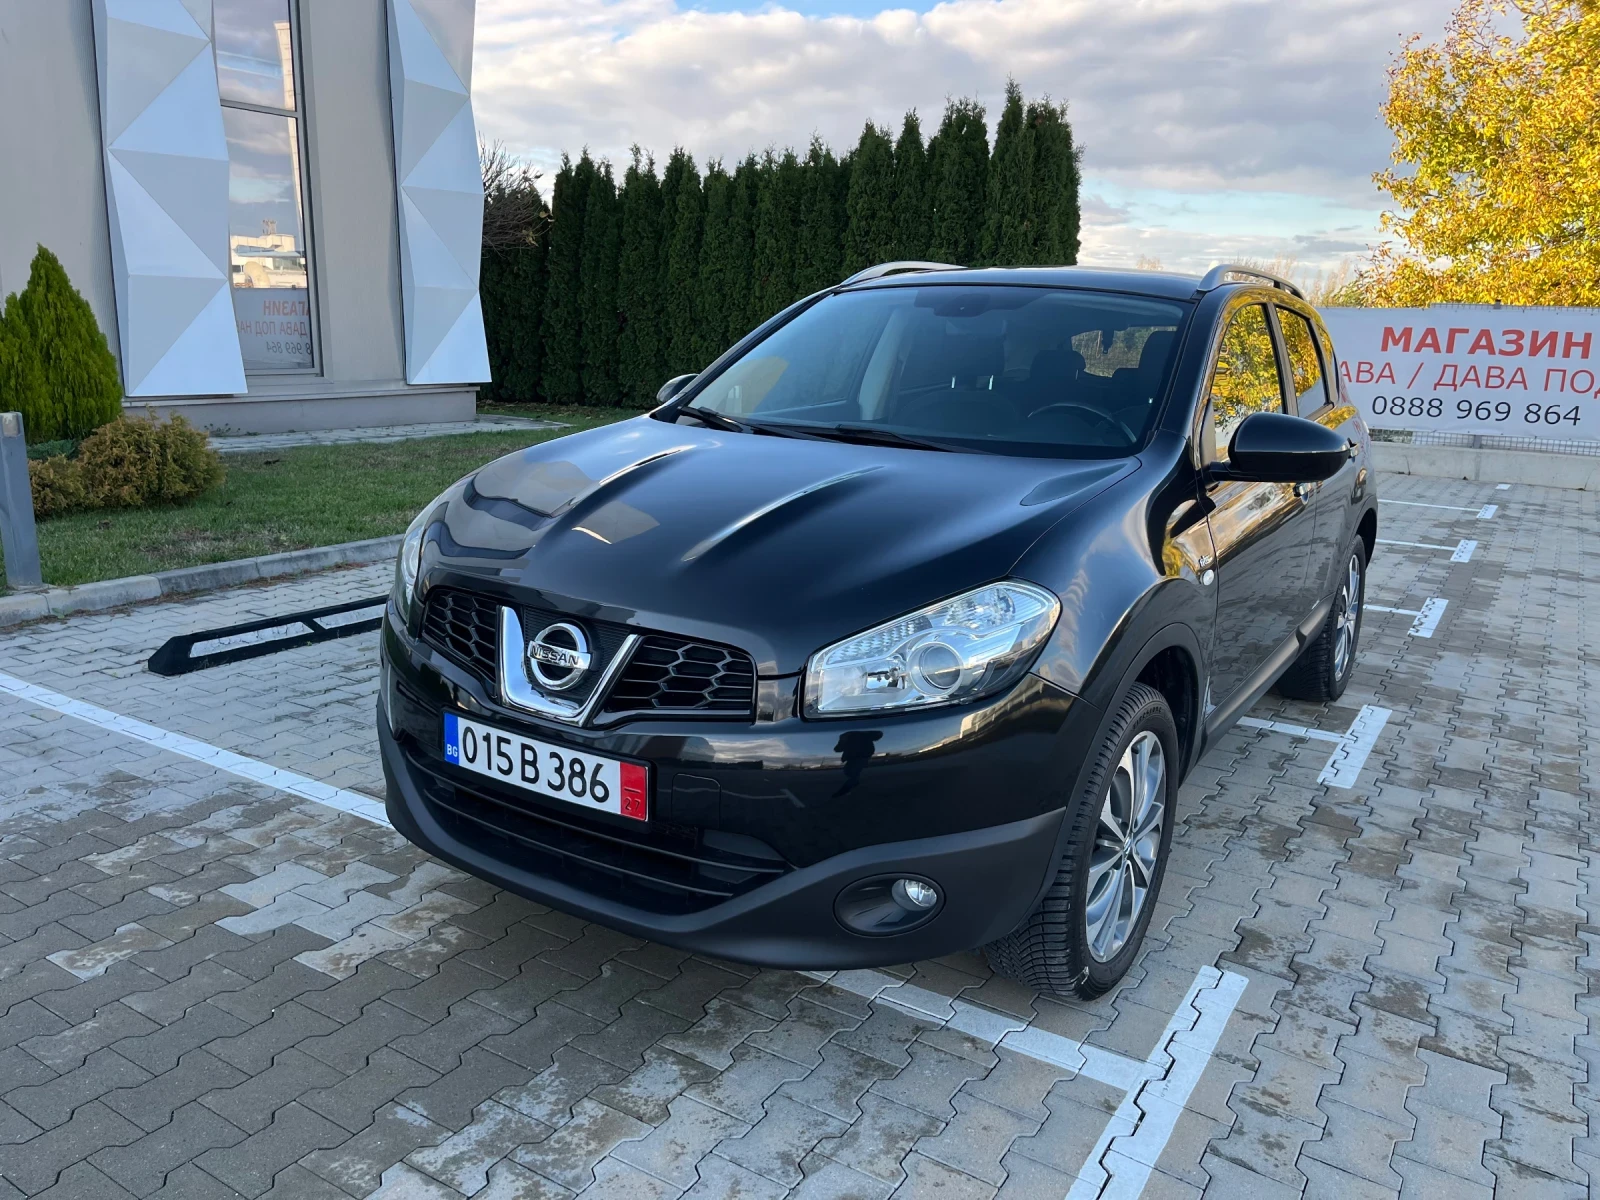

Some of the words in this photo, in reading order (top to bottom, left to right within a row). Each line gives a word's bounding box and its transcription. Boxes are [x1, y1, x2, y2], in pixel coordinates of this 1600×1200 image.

[1380, 327, 1593, 359] МАГАЗИН
[1433, 363, 1528, 392] ДАВА
[1543, 368, 1600, 399] ПО
[1372, 395, 1443, 418] 0888
[1456, 400, 1511, 422] 969
[1524, 403, 1581, 426] 864
[530, 644, 580, 667] NISSAN
[446, 743, 458, 758] BG
[625, 797, 641, 812] 27
